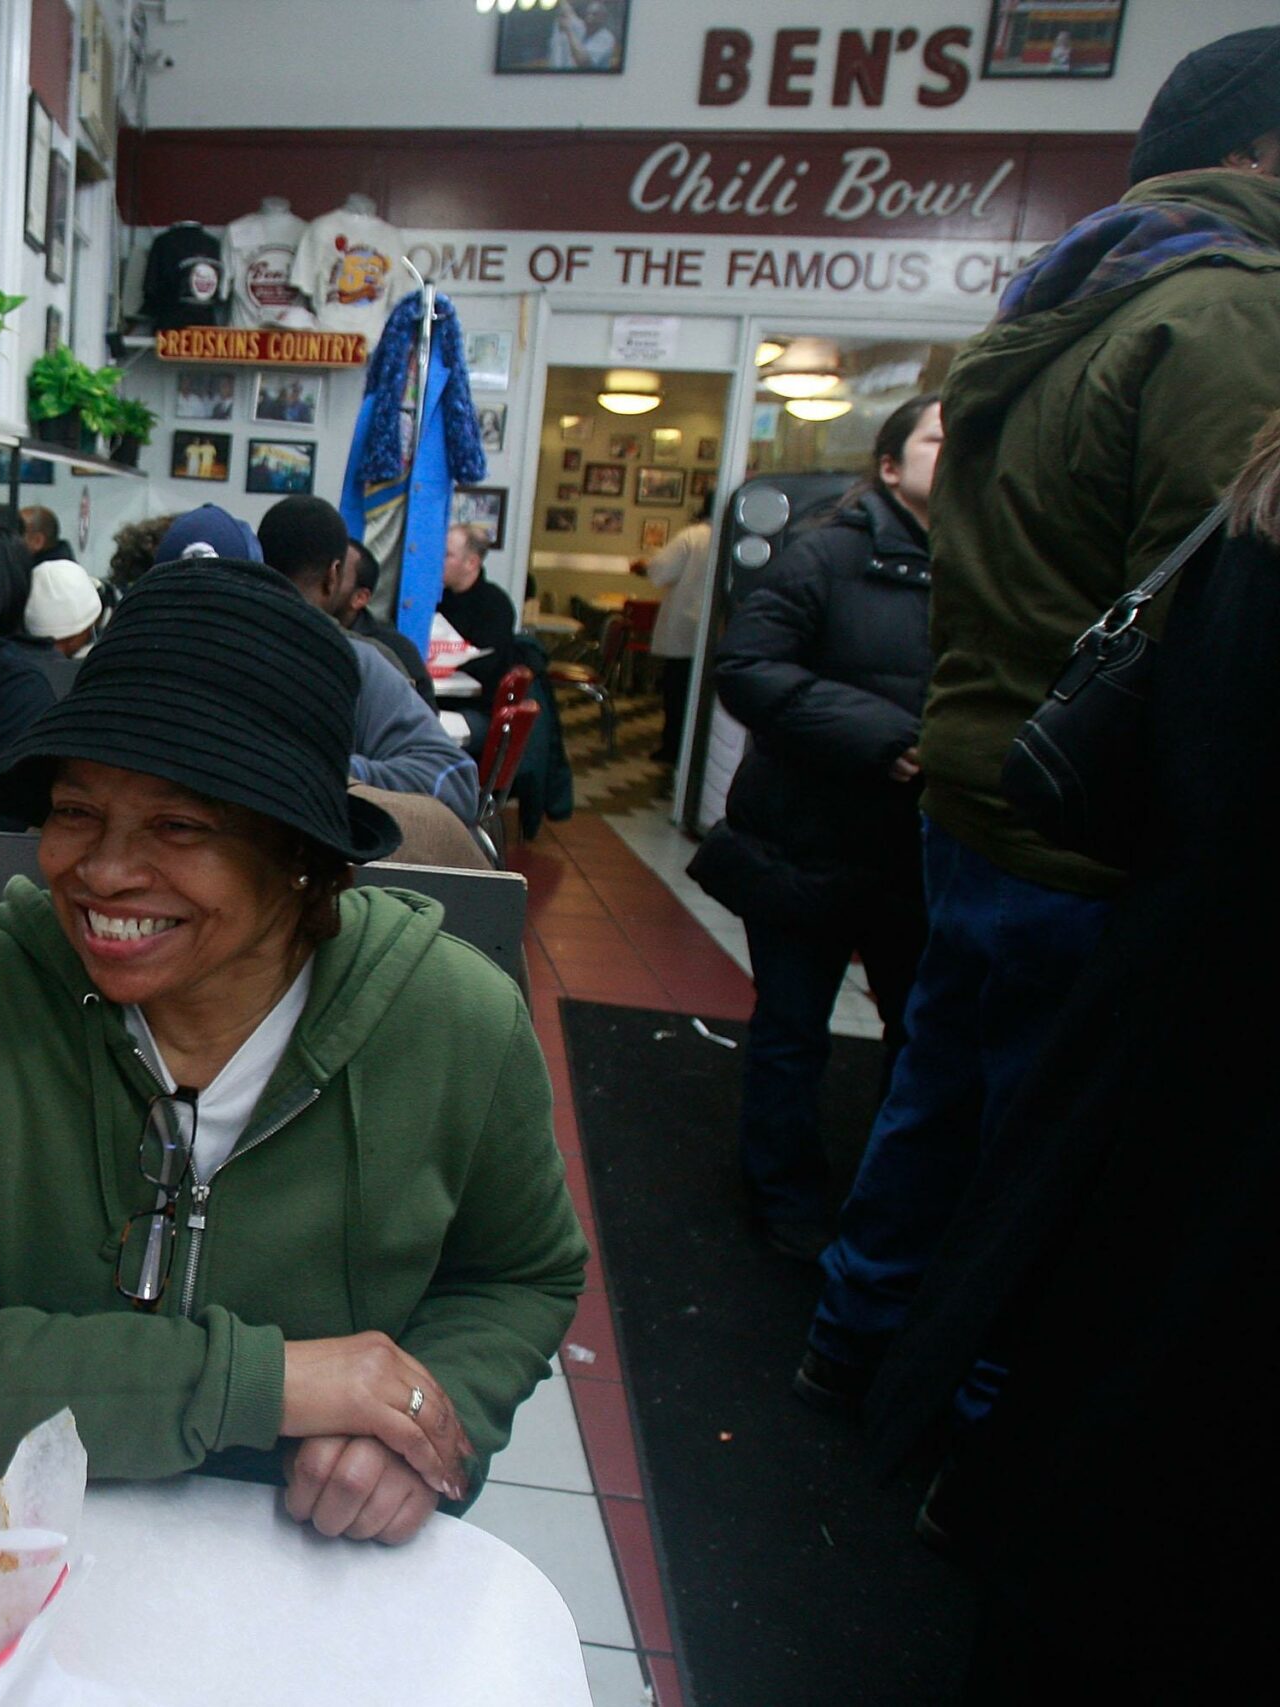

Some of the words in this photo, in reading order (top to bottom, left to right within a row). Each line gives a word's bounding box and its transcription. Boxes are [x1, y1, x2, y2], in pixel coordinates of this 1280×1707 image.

[697, 26, 972, 108] BEN'S
[628, 141, 809, 215] Chili
[824, 147, 1015, 221] Bowl
[528, 244, 595, 284] OF
[614, 247, 703, 287] THE
[726, 250, 931, 294] FAMOUS
[168, 329, 261, 358] REDSKINS
[269, 333, 357, 363] COUNTRY
